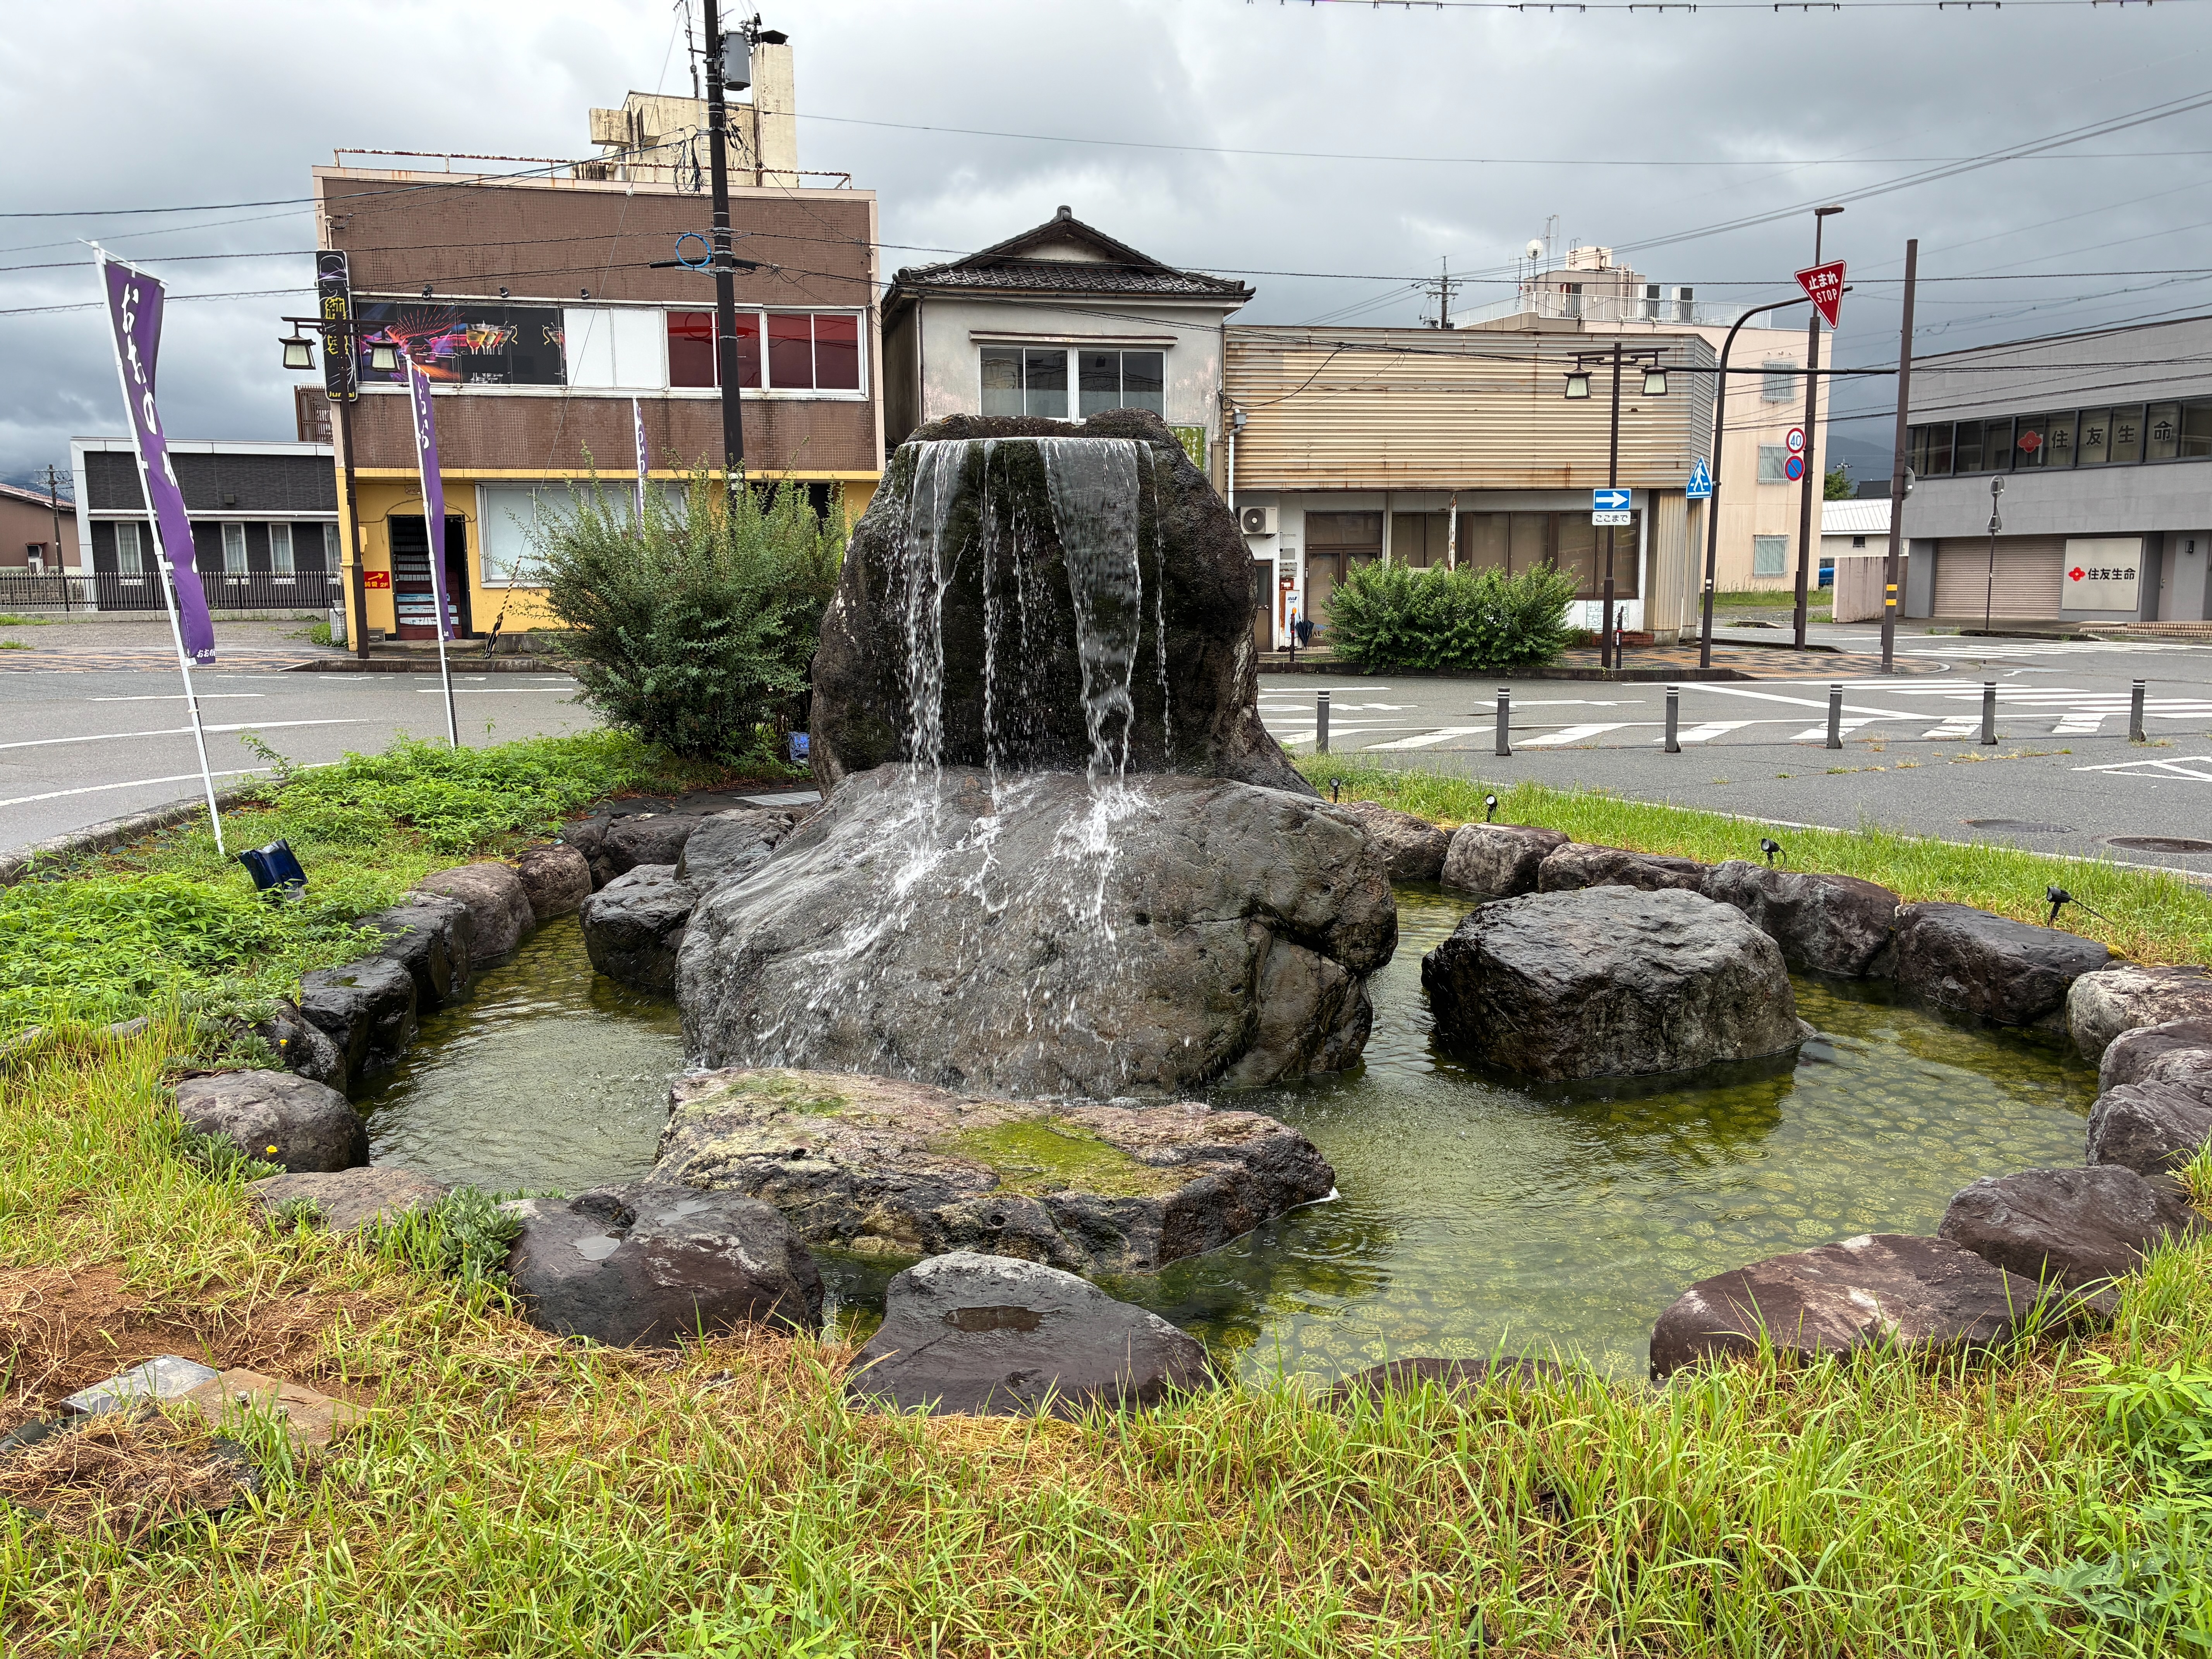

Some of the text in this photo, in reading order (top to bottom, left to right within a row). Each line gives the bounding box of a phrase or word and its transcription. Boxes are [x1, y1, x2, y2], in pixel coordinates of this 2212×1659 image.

[1808, 270, 1839, 290] 止まれ
[1816, 289, 1838, 303] STOP
[1790, 435, 1802, 447] 40
[2051, 420, 2173, 449] 住友生命
[1595, 514, 1629, 522] ここまで
[2087, 568, 2136, 580] 住友生命
